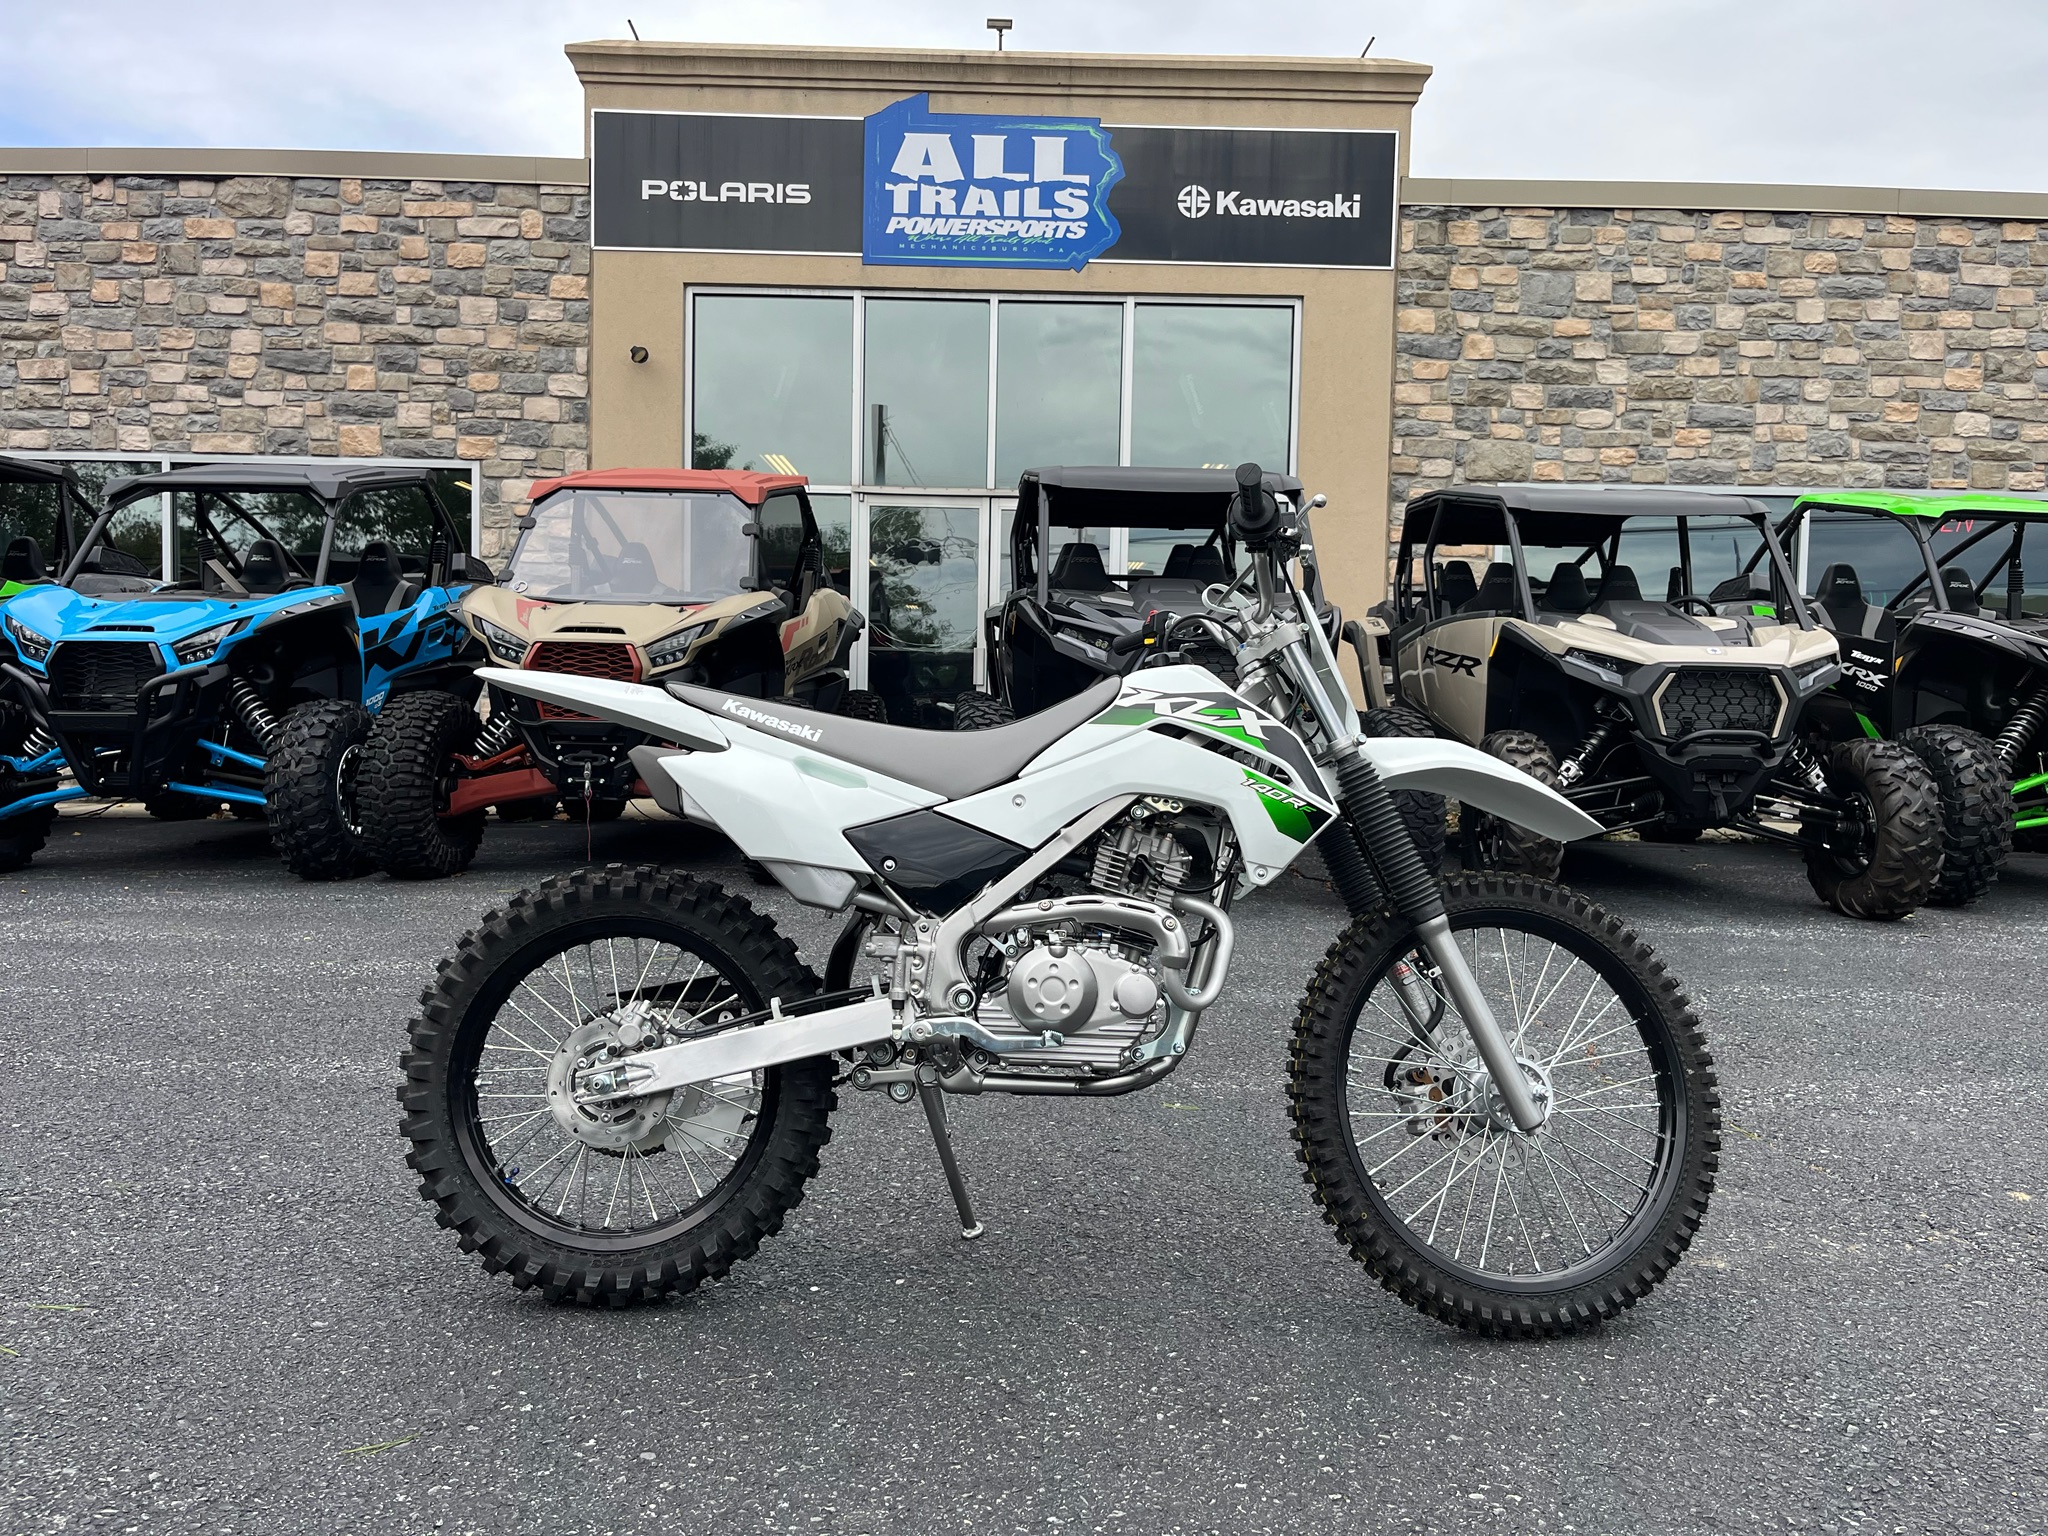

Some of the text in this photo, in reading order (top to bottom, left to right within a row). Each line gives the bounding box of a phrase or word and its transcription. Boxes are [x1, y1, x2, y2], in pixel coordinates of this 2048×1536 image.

[890, 132, 1090, 187] ALL
[641, 179, 812, 204] POLARIS
[885, 182, 1090, 219] TRAILS
[1216, 190, 1361, 218] Kawasaki
[885, 216, 1088, 240] POWERSPORTS
[1422, 645, 1483, 678] RZR
[1850, 649, 1885, 664] Teryx
[1840, 662, 1889, 688] KRX
[1855, 680, 1879, 692] 1000
[721, 698, 824, 742] Kawasaki
